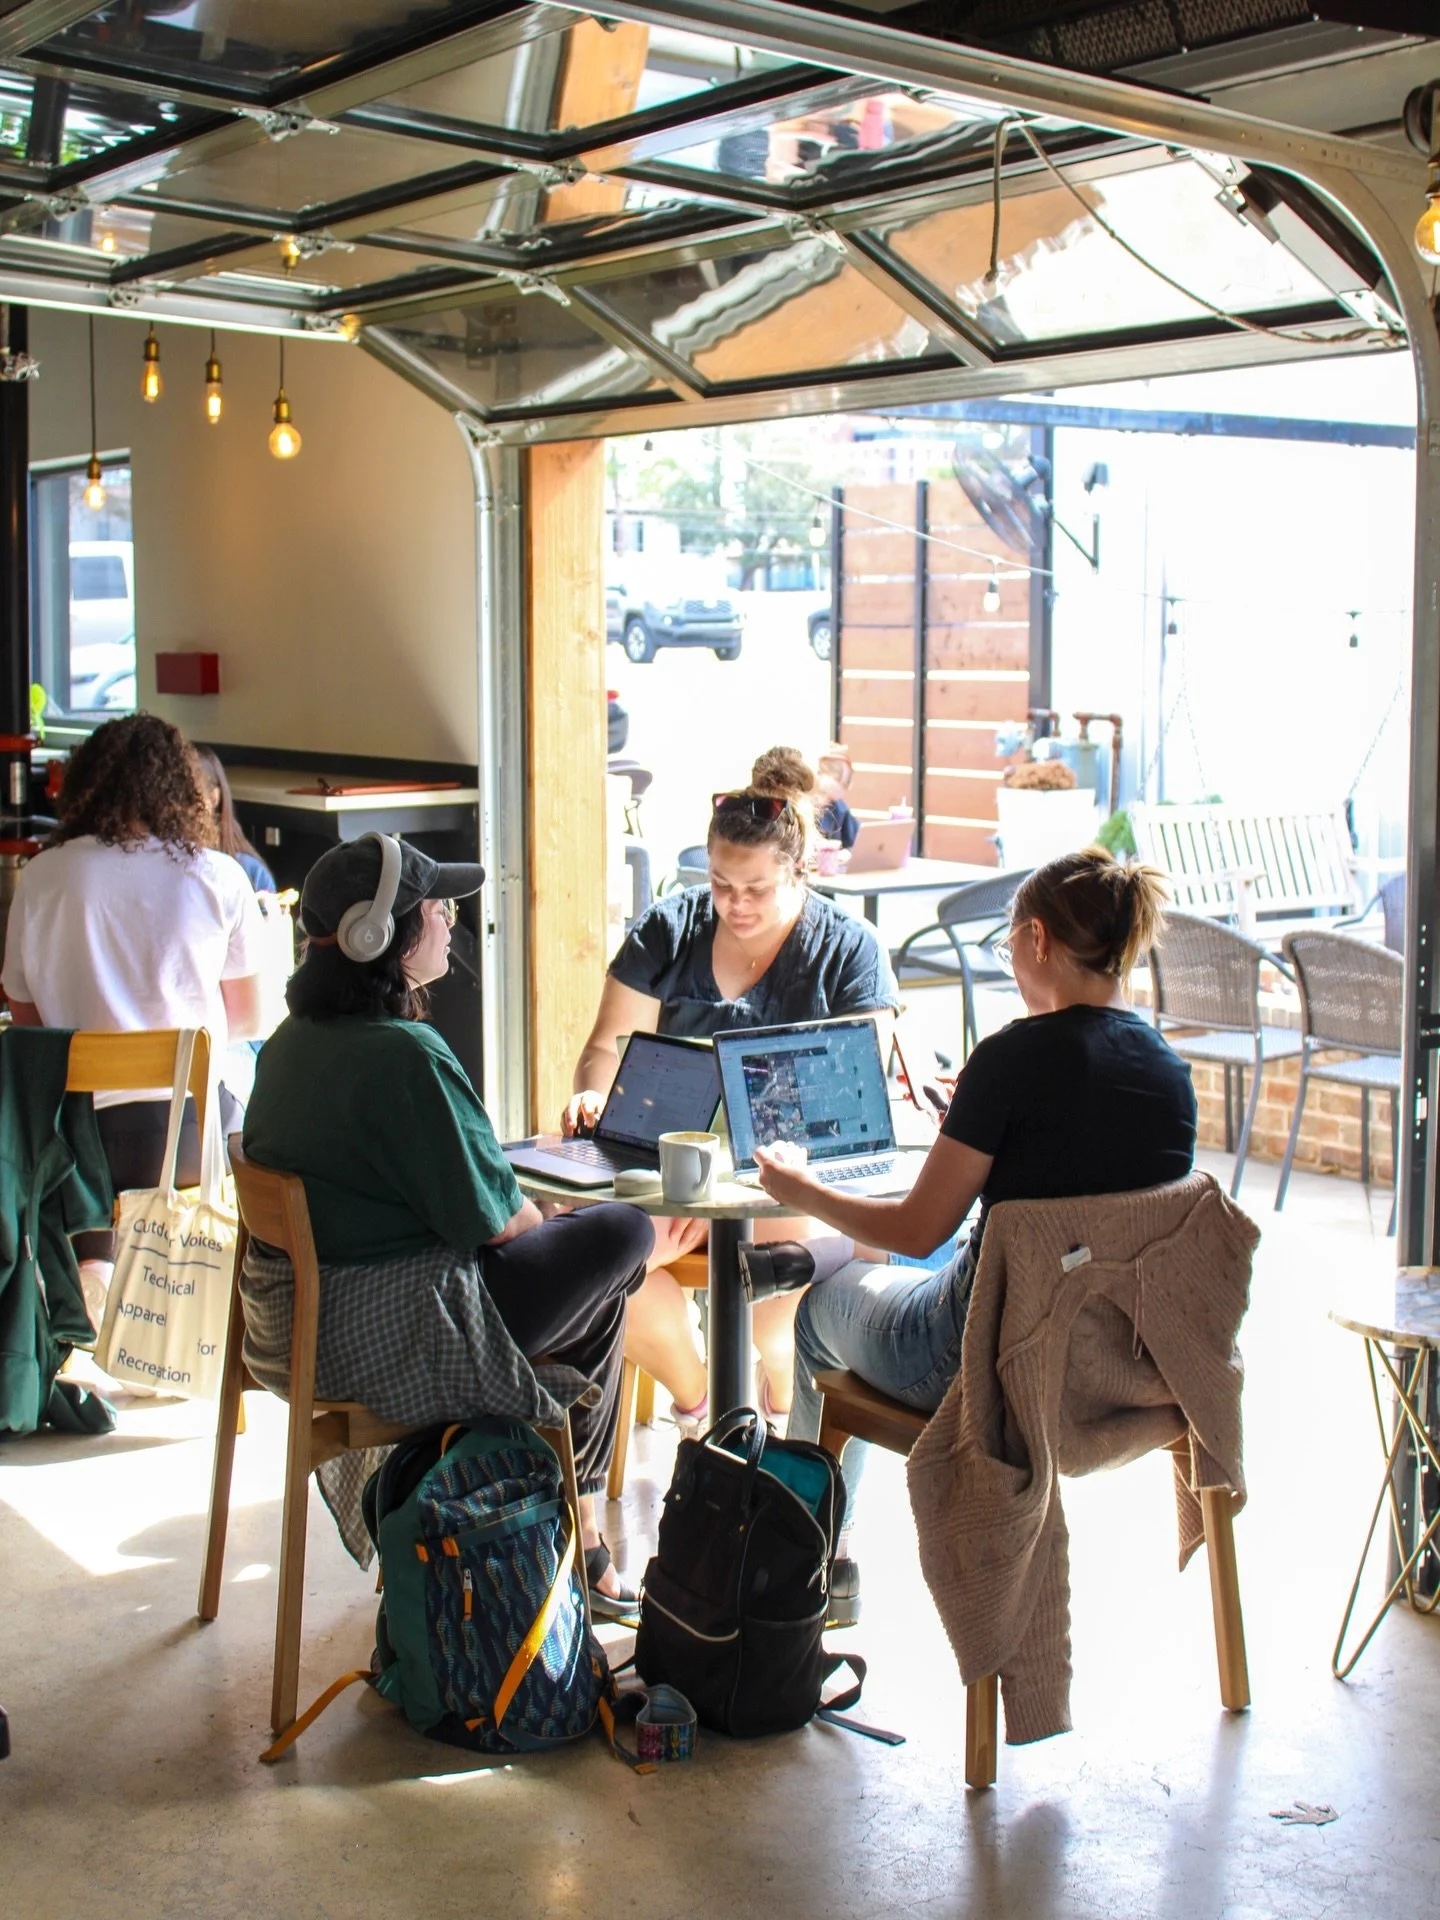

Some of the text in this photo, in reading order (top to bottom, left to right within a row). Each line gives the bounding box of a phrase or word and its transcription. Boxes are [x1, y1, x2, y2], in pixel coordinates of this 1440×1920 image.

[133, 1218, 223, 1252] Outdr Voices
[117, 1298, 168, 1326] Apparel
[197, 1338, 217, 1355] for
[117, 1348, 191, 1383] Recreation
